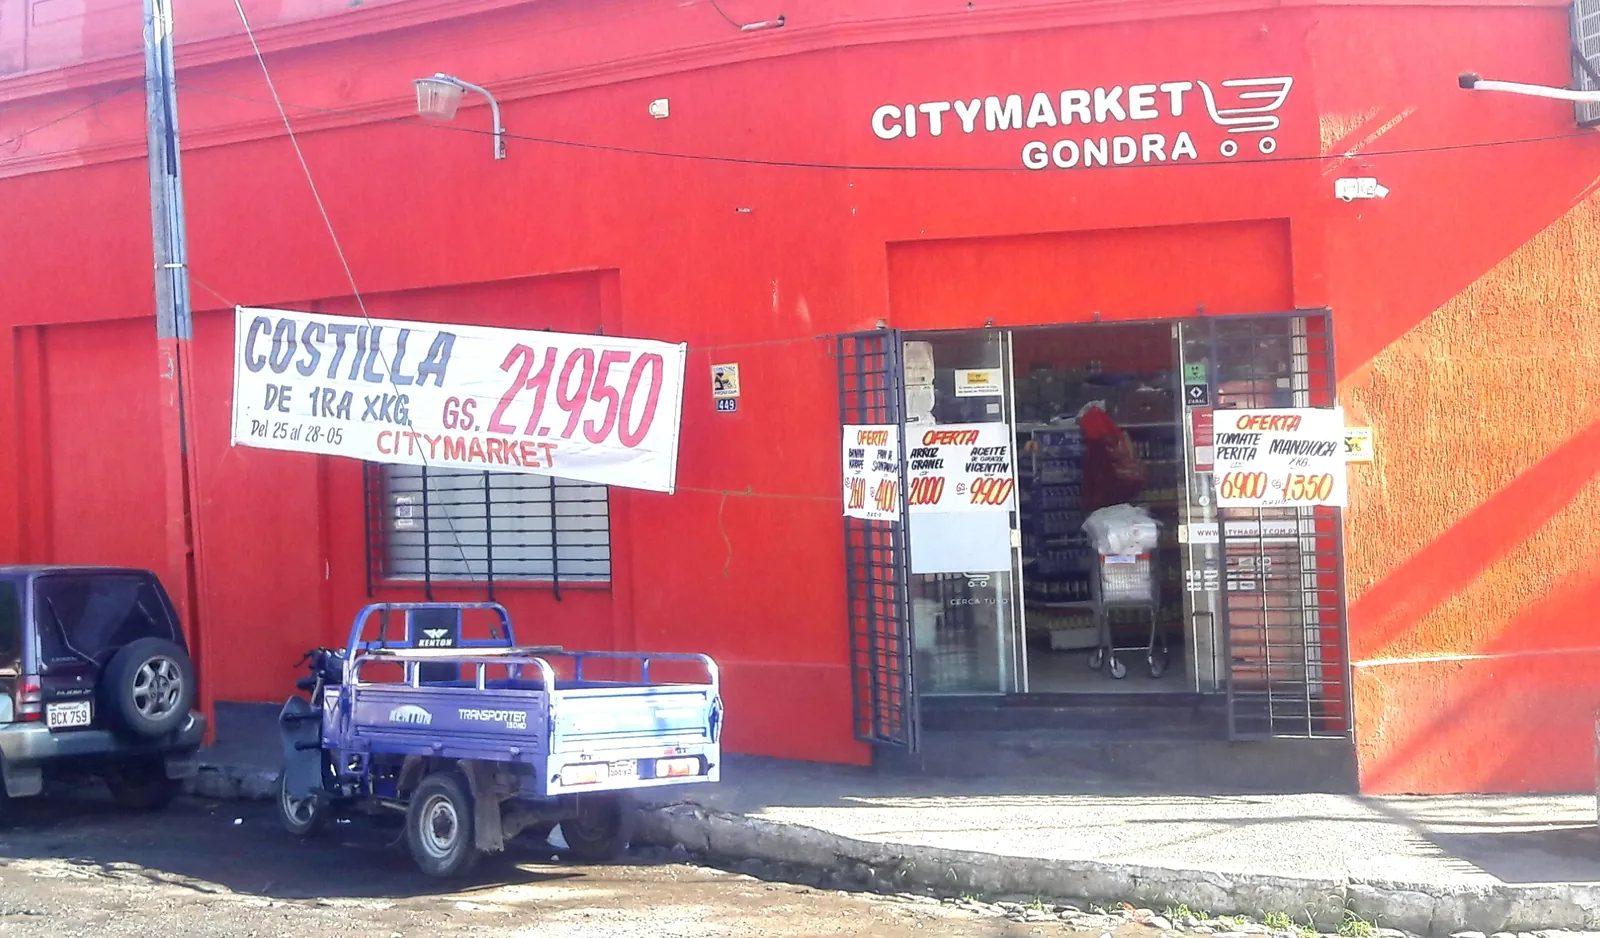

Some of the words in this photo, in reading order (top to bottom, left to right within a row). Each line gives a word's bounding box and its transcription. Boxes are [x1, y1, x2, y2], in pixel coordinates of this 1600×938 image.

[871, 80, 1194, 140] CITYMARKET
[1021, 131, 1198, 170] GONDRA
[244, 316, 456, 388] COSTILLA
[264, 384, 292, 413] DE
[309, 386, 352, 421] 1RA
[443, 397, 480, 432] GS.
[488, 343, 664, 448] 21.950
[719, 400, 735, 410] 449
[1236, 414, 1303, 432] OFERTA
[251, 419, 269, 438] Del
[272, 421, 288, 440] 25
[290, 424, 302, 443] al
[306, 425, 343, 446] 28-05
[857, 430, 889, 446] OFERTA
[922, 430, 980, 446] OFERTA
[1215, 432, 1263, 446] TOMATE
[376, 430, 559, 469] CITYMARKET
[910, 447, 939, 459] ARROZ
[970, 446, 1007, 457] ACEITE
[1216, 446, 1258, 461] PERITA
[1268, 439, 1338, 457] MANDIOCA
[911, 458, 944, 470] GRANEL
[965, 462, 1009, 474] VICENTIN
[950, 598, 981, 606] CERCA
[418, 639, 452, 647] KENTON
[51, 711, 67, 724] BCX
[70, 710, 87, 724] 759
[389, 709, 433, 725] KENTON
[458, 708, 527, 723] TRANSPORTER
